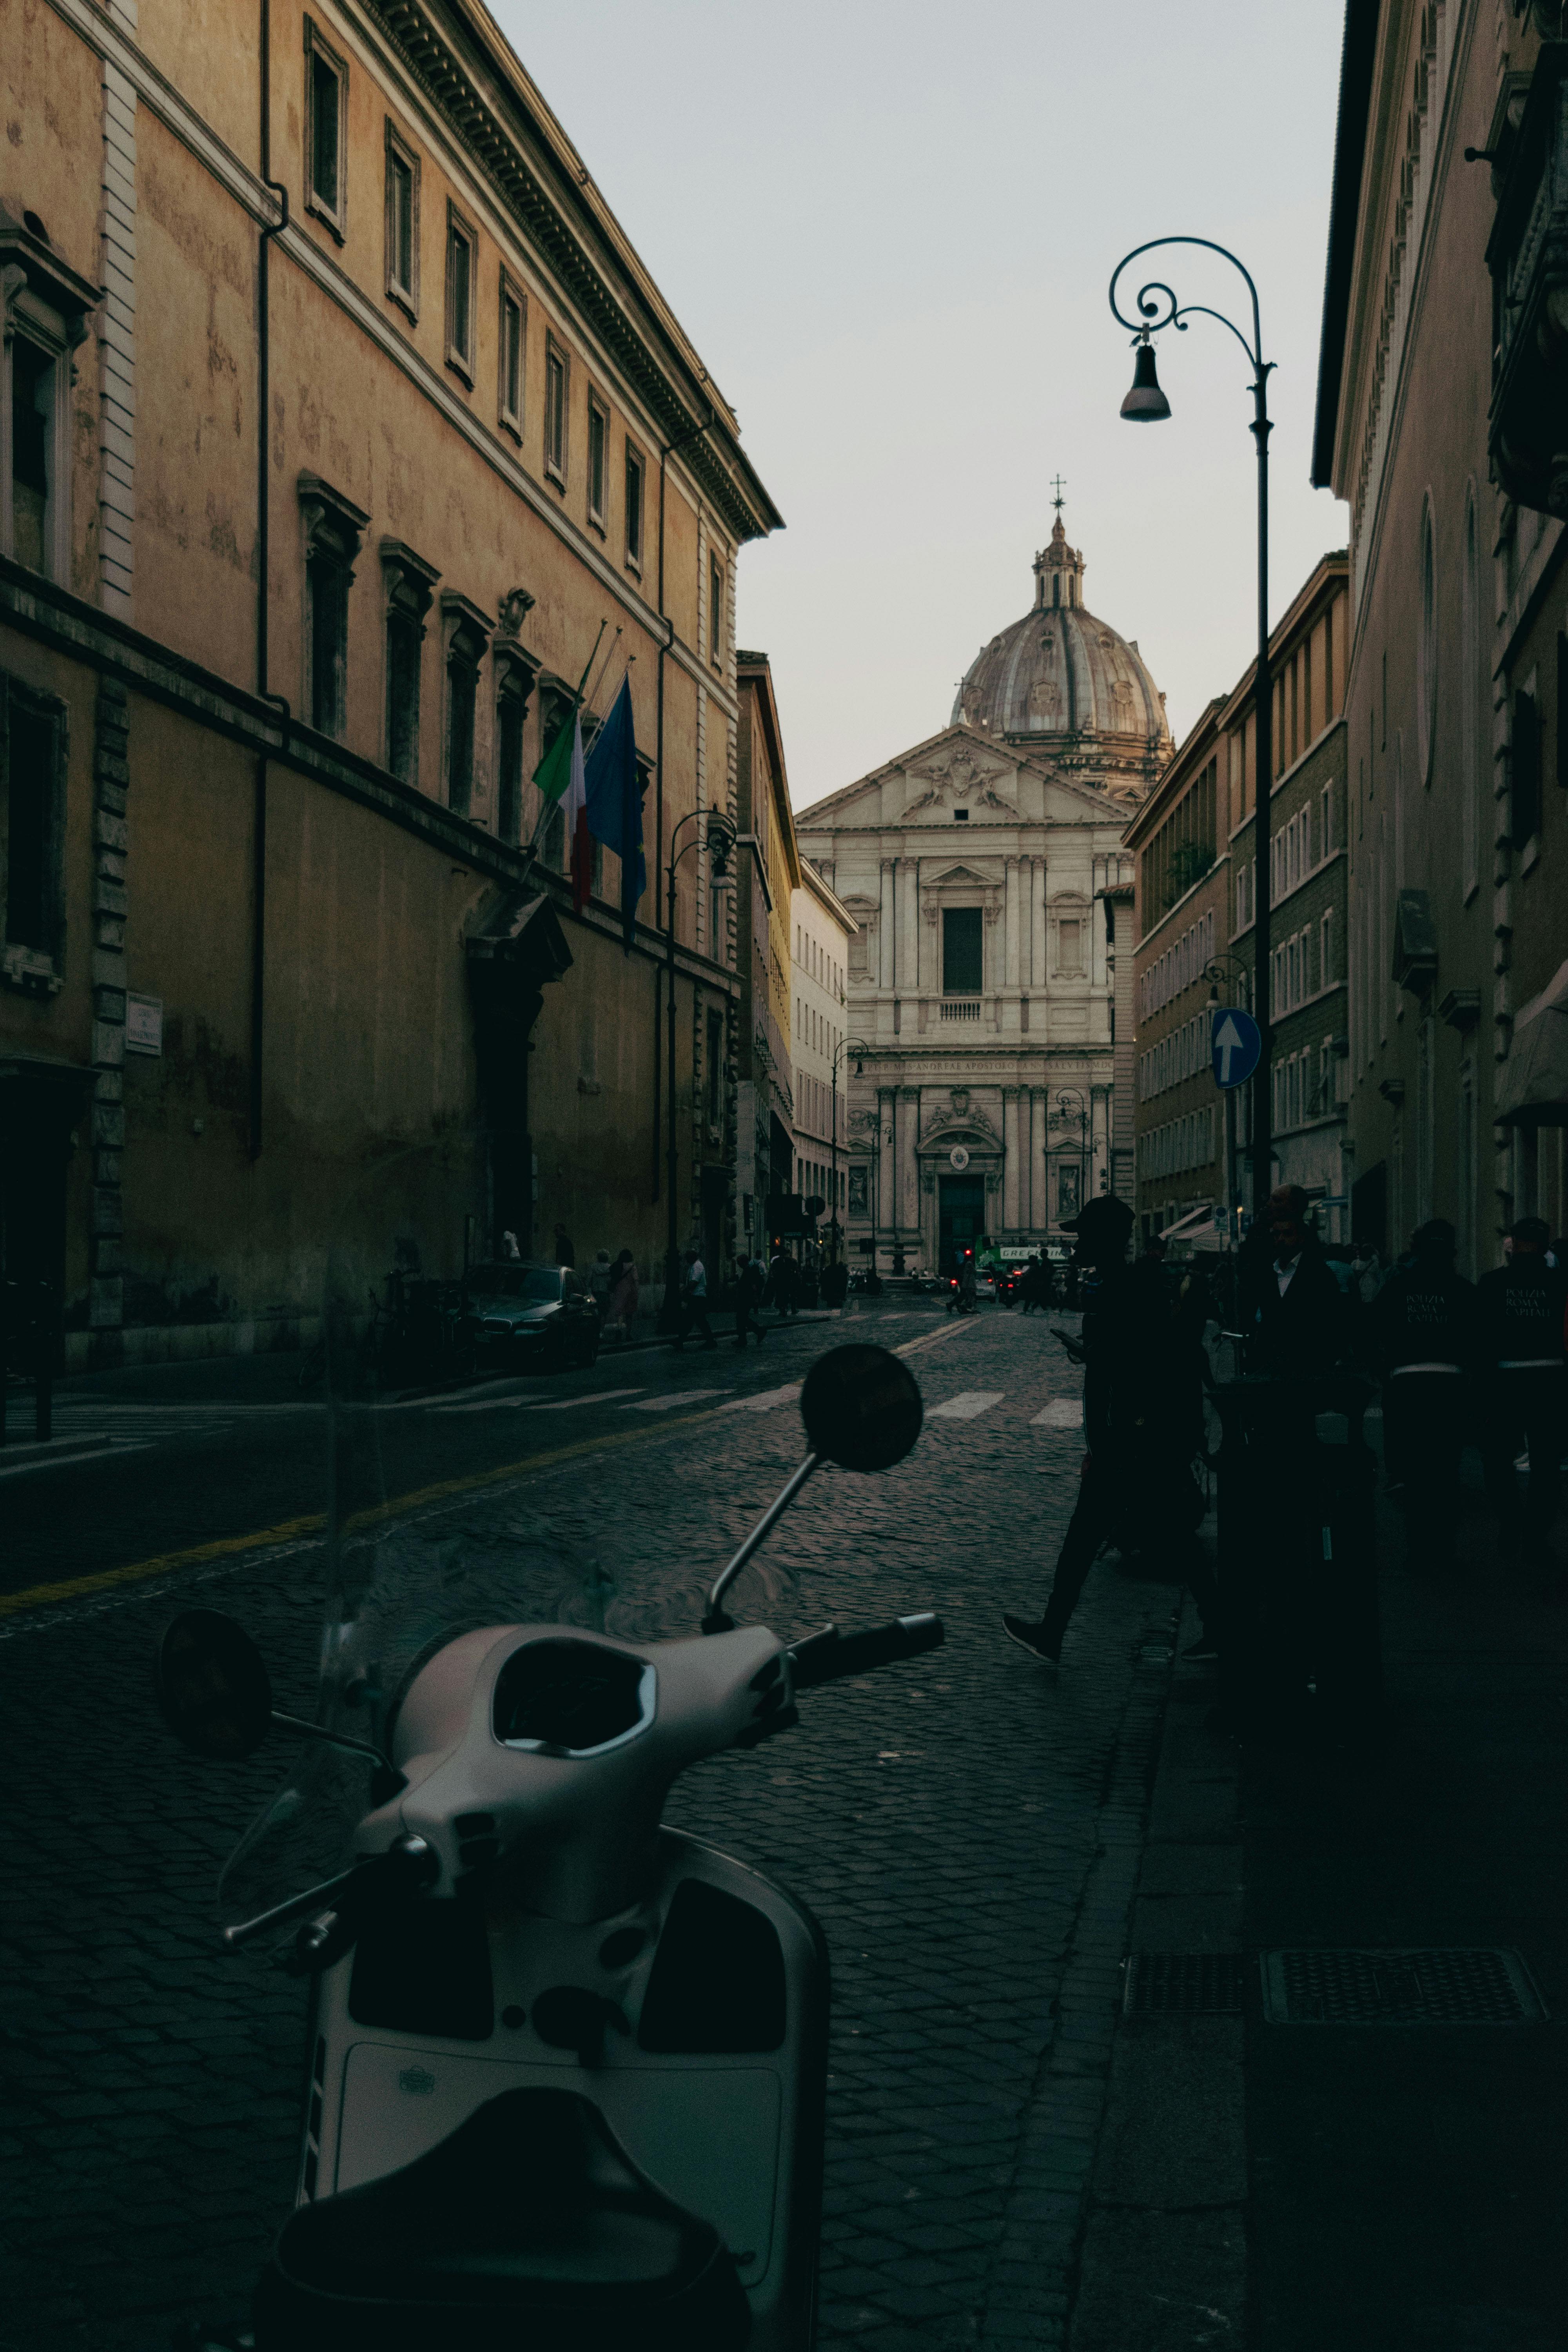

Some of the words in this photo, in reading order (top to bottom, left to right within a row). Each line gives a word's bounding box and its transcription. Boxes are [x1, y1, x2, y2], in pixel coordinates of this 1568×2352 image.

[1506, 1289, 1546, 1298] POLIZIA
[1406, 1294, 1445, 1304] POLIZIA
[1506, 1298, 1539, 1307] ROMA
[1407, 1303, 1437, 1314] ROMA
